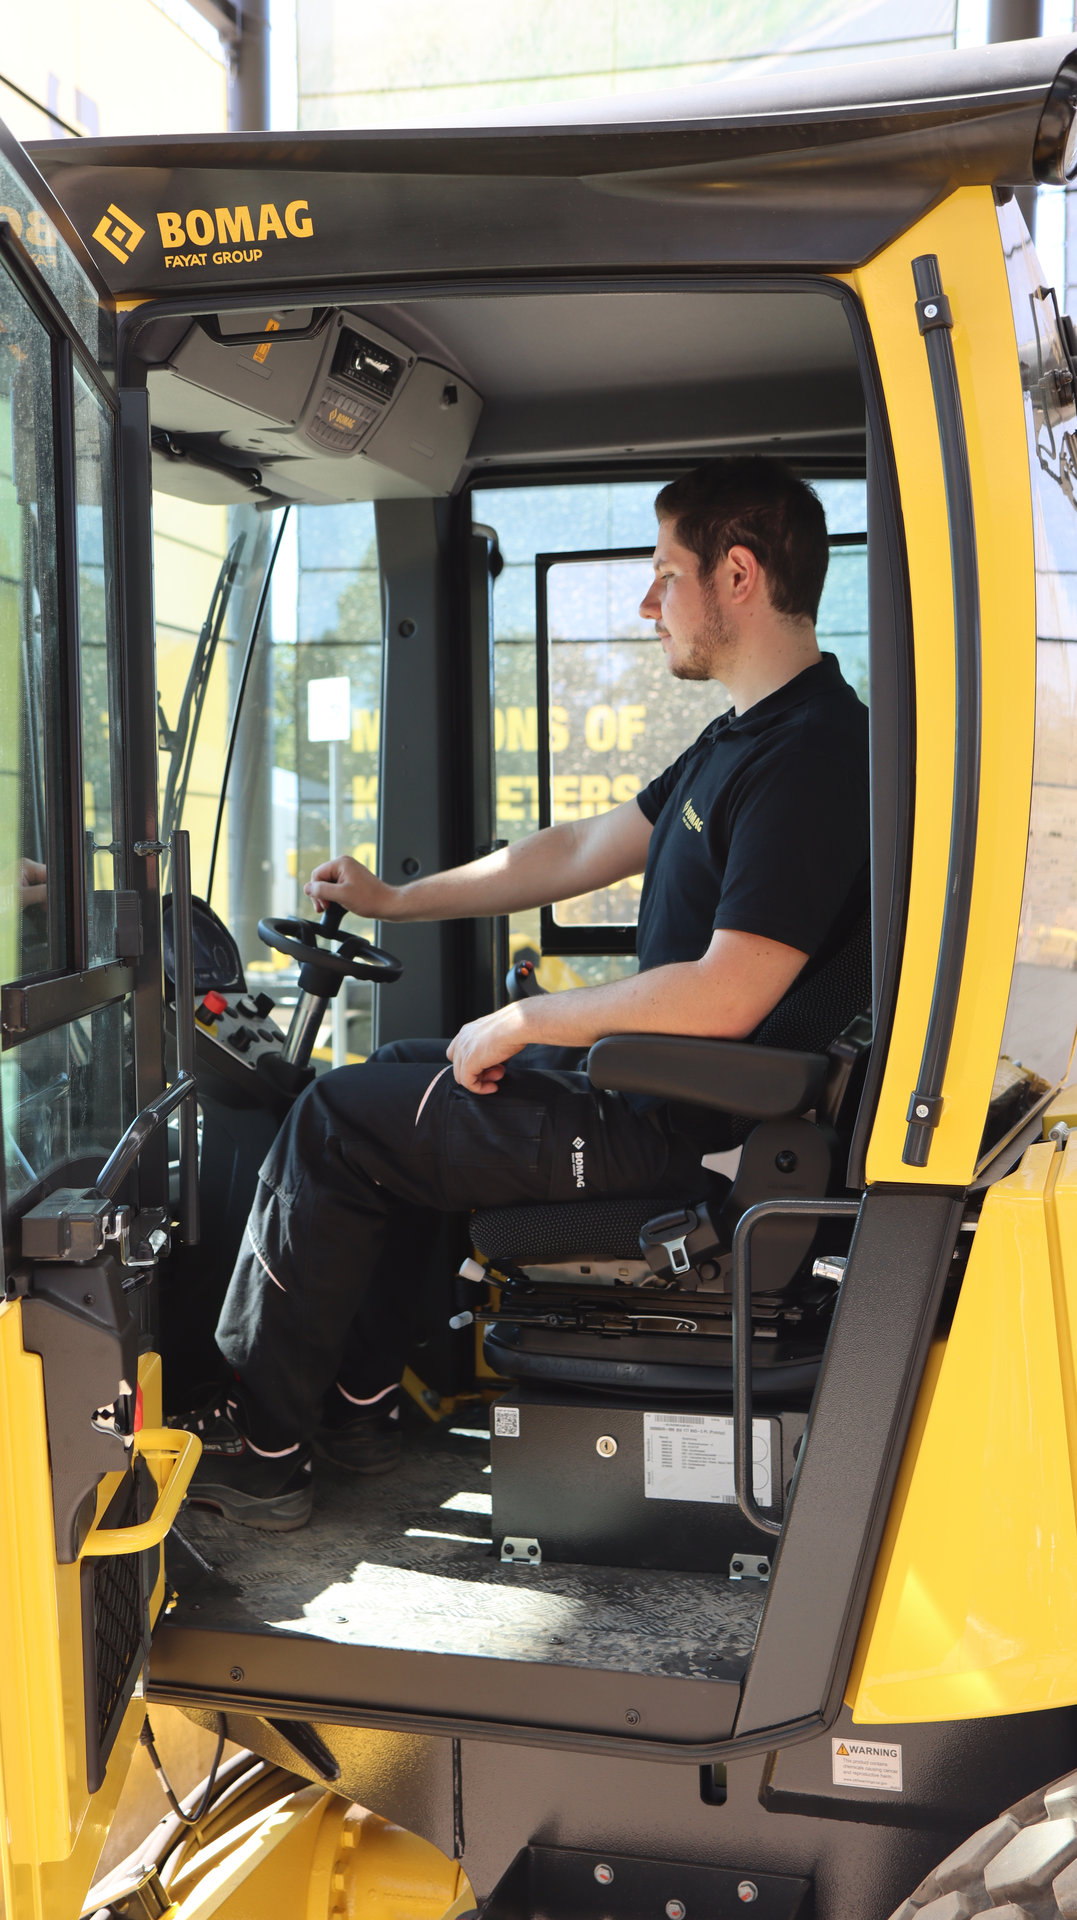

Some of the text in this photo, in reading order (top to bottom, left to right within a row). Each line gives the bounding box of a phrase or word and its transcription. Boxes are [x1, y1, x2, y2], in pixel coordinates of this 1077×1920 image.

[157, 200, 314, 249] BOMAG
[164, 249, 263, 268] FAYAT GROUP
[336, 413, 356, 429] BOMAG
[585, 705, 646, 751] OF
[685, 805, 704, 833] BOMAG
[575, 1151, 585, 1188] BOMAG
[536, 1358, 645, 1382] GRAMMER
[849, 1745, 898, 1758] WARNING
